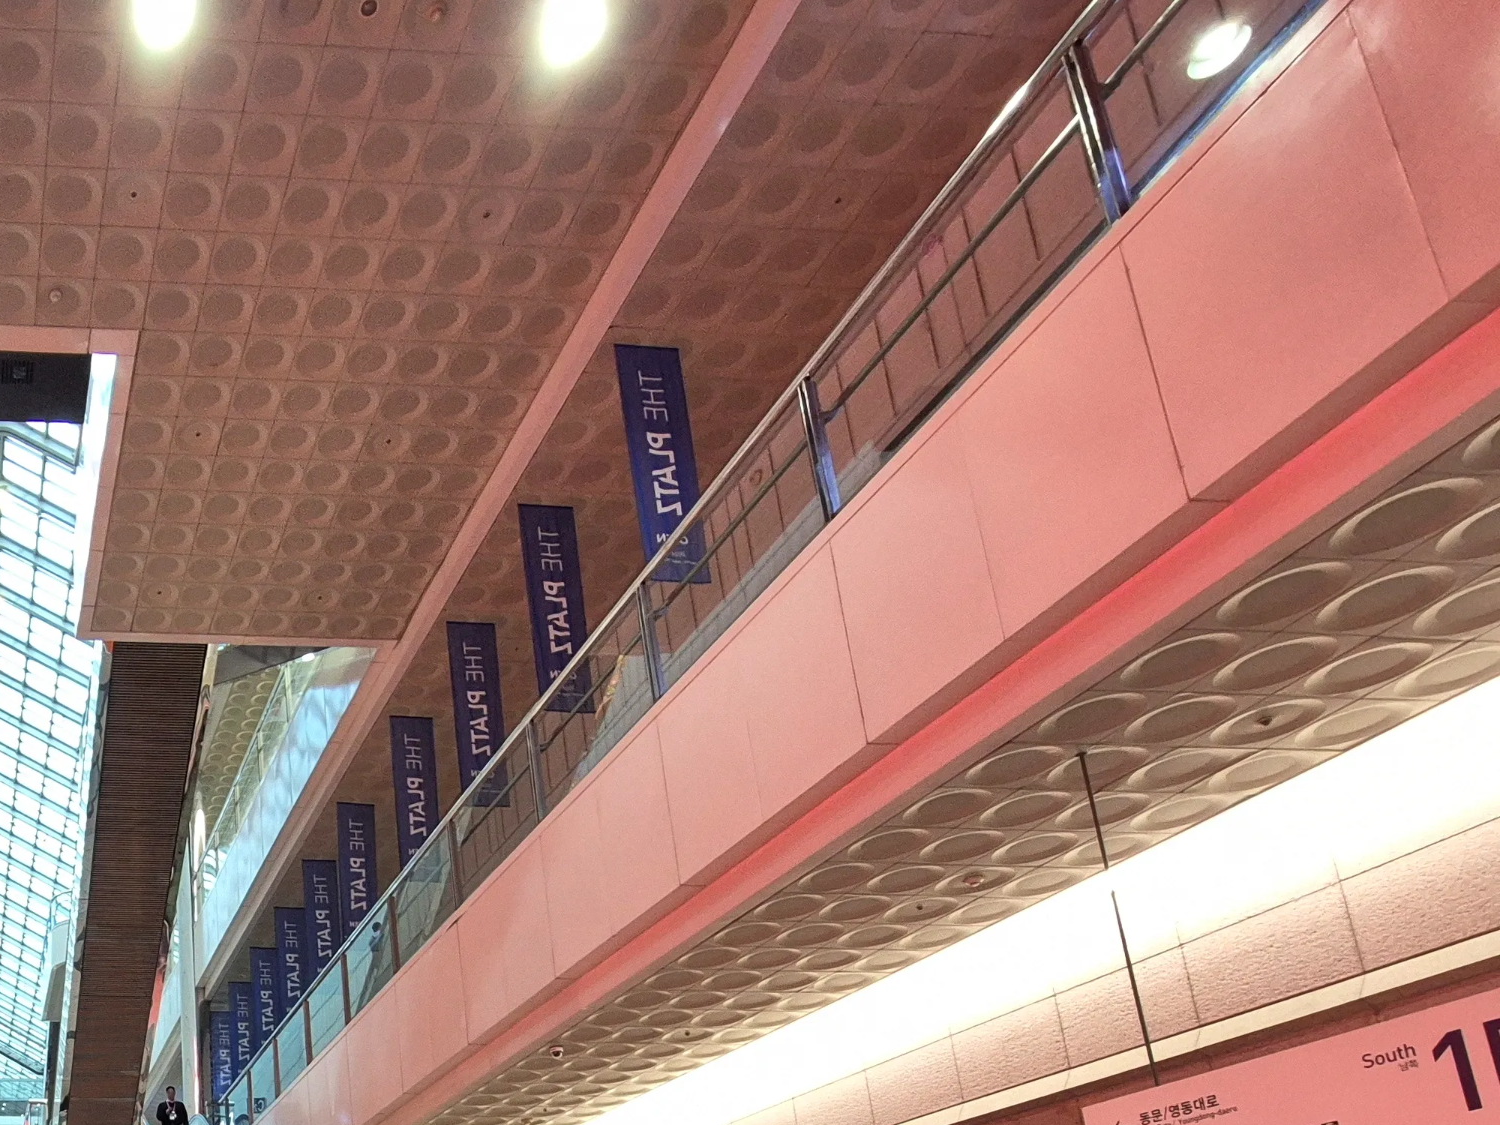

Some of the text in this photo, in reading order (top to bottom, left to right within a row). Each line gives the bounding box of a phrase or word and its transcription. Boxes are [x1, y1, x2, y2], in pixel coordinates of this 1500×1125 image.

[1361, 1043, 1417, 1069] South
[1398, 1059, 1419, 1072] 남쪽
[1139, 1094, 1220, 1125] 동문/영동대로
